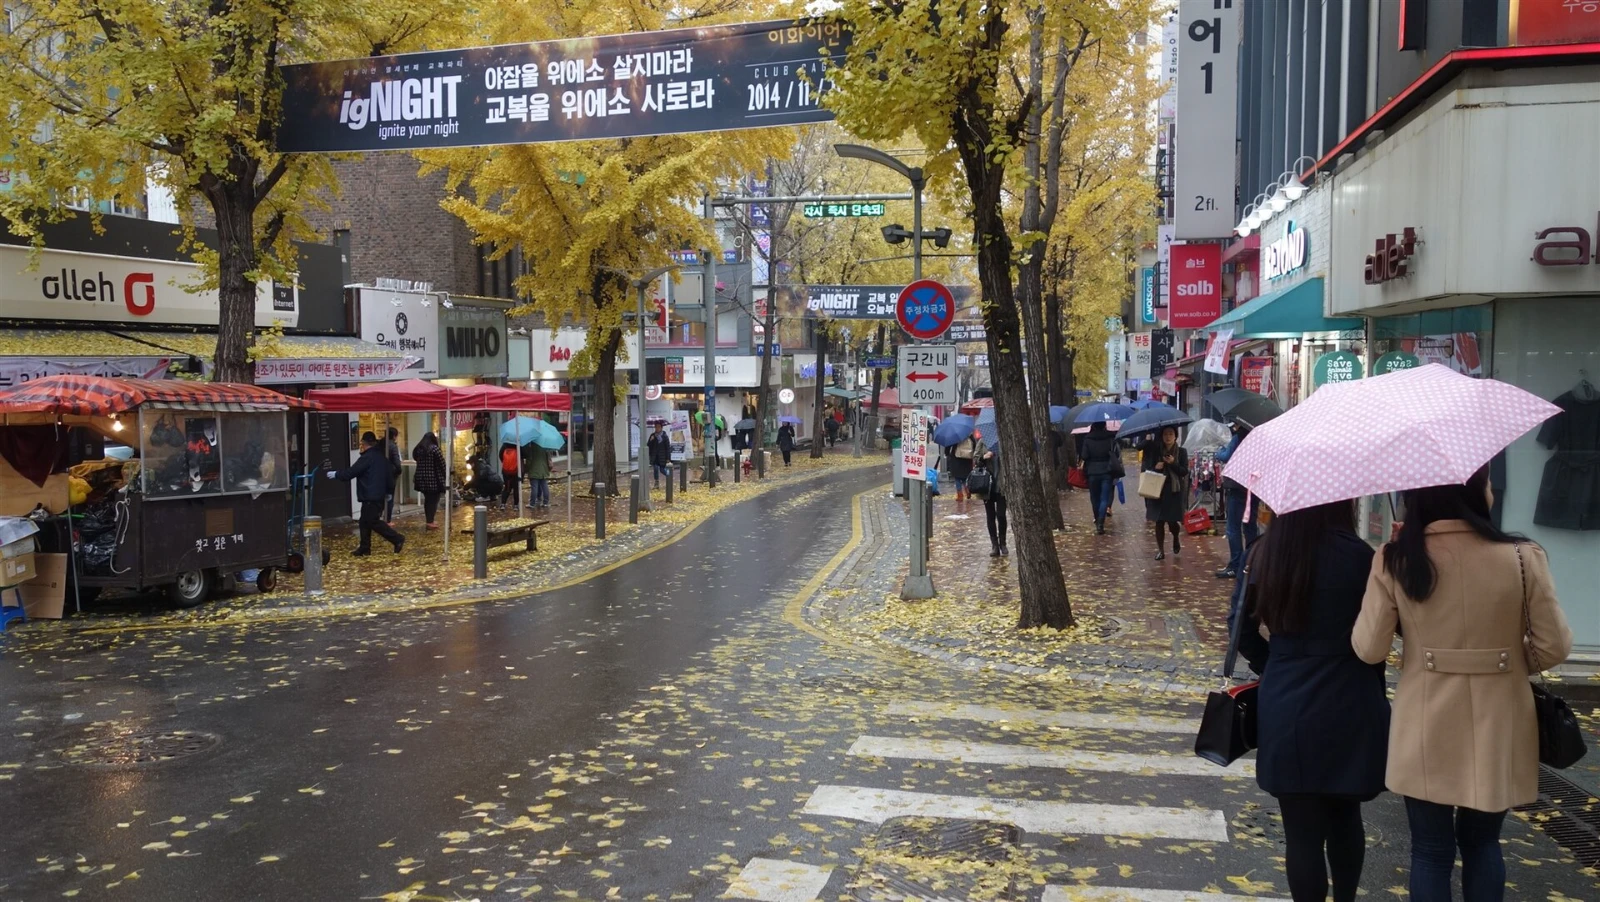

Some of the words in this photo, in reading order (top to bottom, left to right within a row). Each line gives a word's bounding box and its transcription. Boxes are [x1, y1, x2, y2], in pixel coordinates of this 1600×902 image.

[768, 22, 840, 47] 이화이언
[612, 48, 694, 81] 살지마라
[754, 65, 789, 79] CLUB
[339, 75, 462, 131] igNIGHT
[640, 78, 716, 113] 사로라
[378, 123, 406, 141] ignite
[408, 124, 432, 139] your
[434, 118, 460, 138] night
[828, 204, 847, 216] 즉시
[1194, 195, 1219, 211] 2fl.
[41, 268, 115, 303] olleh
[1176, 280, 1214, 296] solb
[806, 293, 860, 311] igNIGHT
[867, 292, 887, 304] 교복
[866, 303, 897, 315] 오늘부
[905, 303, 947, 316] 주정차금지
[1173, 310, 1217, 318] www.solb.co.kr
[446, 326, 500, 358] MIHO
[907, 352, 948, 367] 구간내
[1327, 359, 1353, 368] Save
[308, 363, 332, 377] 아이폰
[1327, 372, 1353, 380] Save
[912, 388, 944, 400] 400m
[910, 412, 919, 454] APM
[918, 415, 927, 456] 웨딩홀
[904, 455, 924, 467] 주차장
